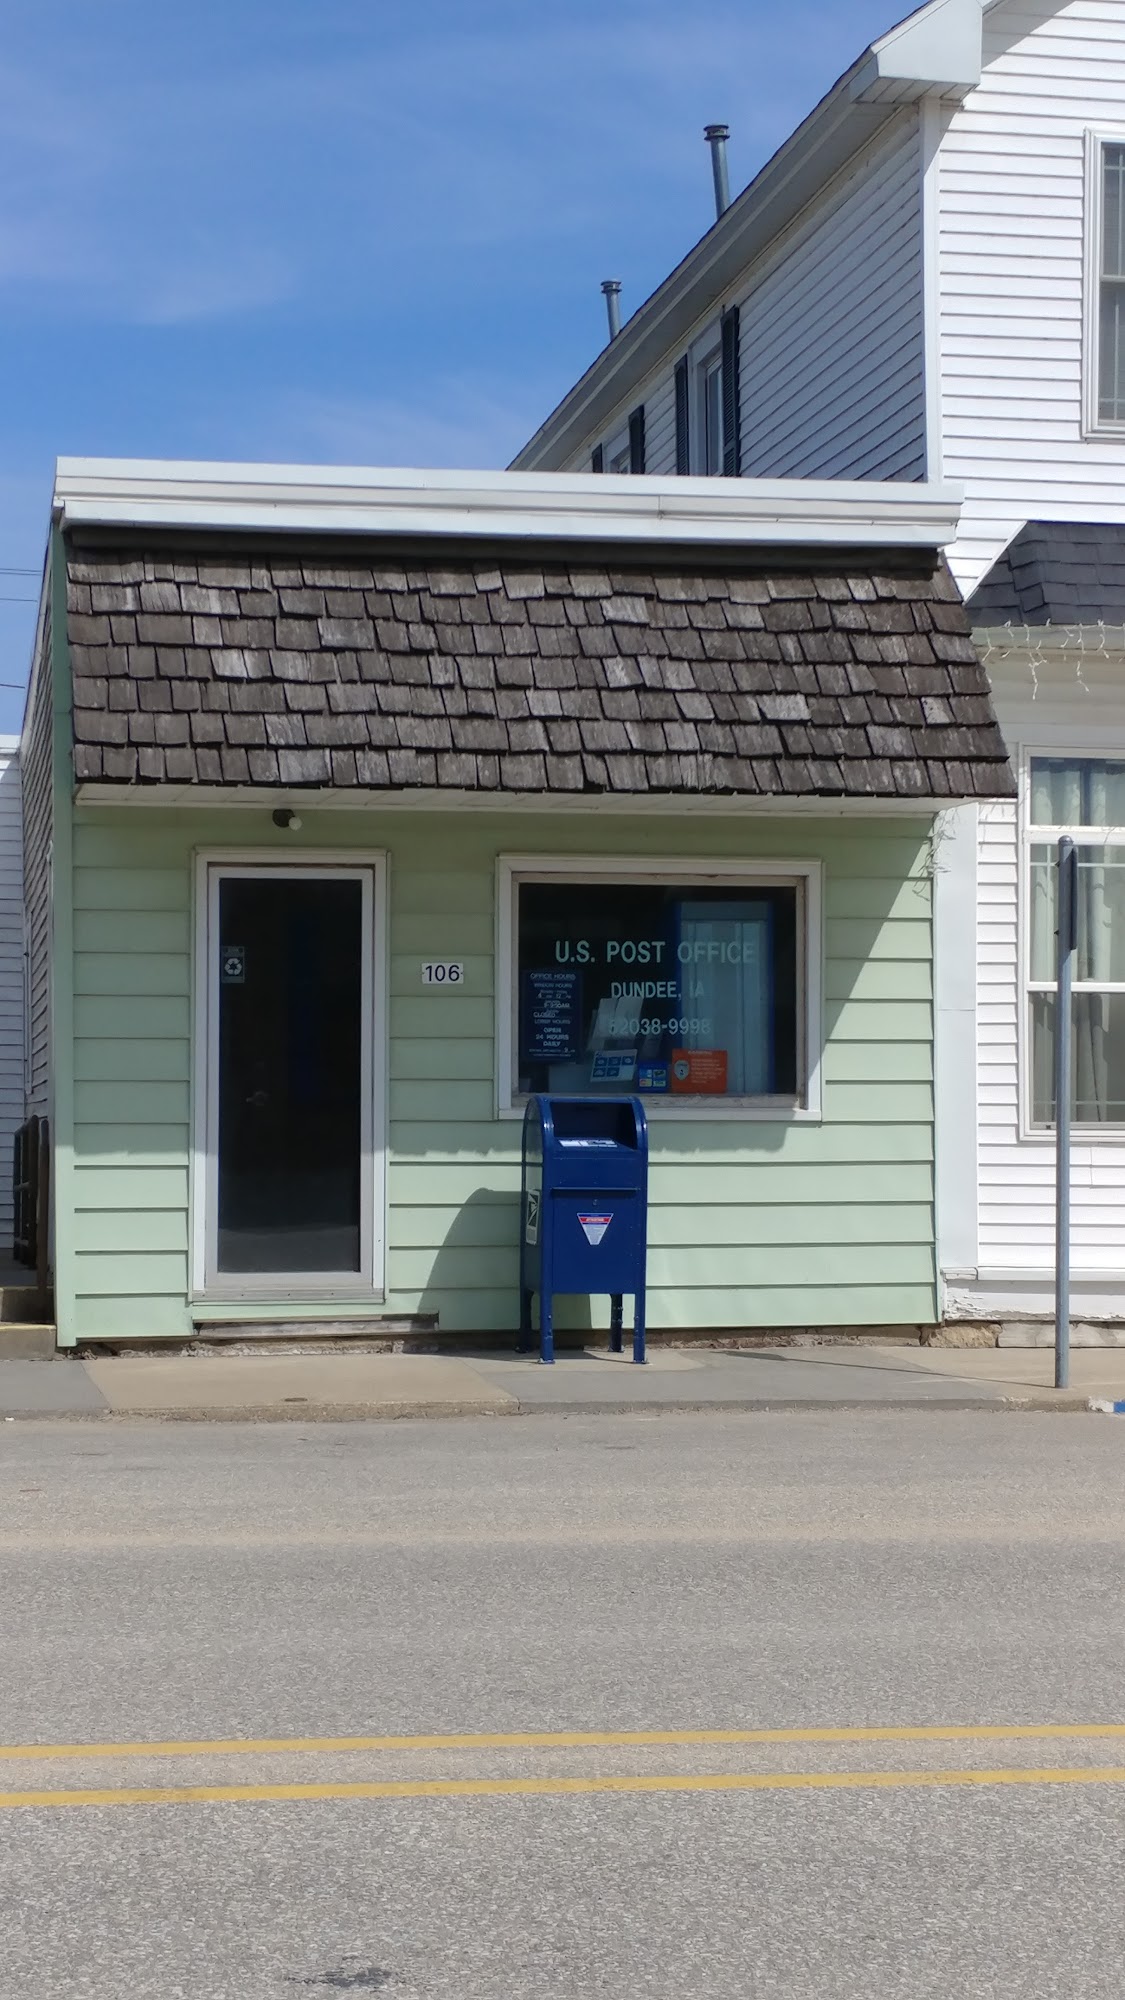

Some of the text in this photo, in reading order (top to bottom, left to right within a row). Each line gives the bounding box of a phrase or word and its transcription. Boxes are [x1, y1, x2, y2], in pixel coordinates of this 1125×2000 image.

[555, 940, 755, 964] U.S. POST OFFICE
[425, 964, 461, 982] 106
[610, 981, 705, 1000] DUNDEE, IA
